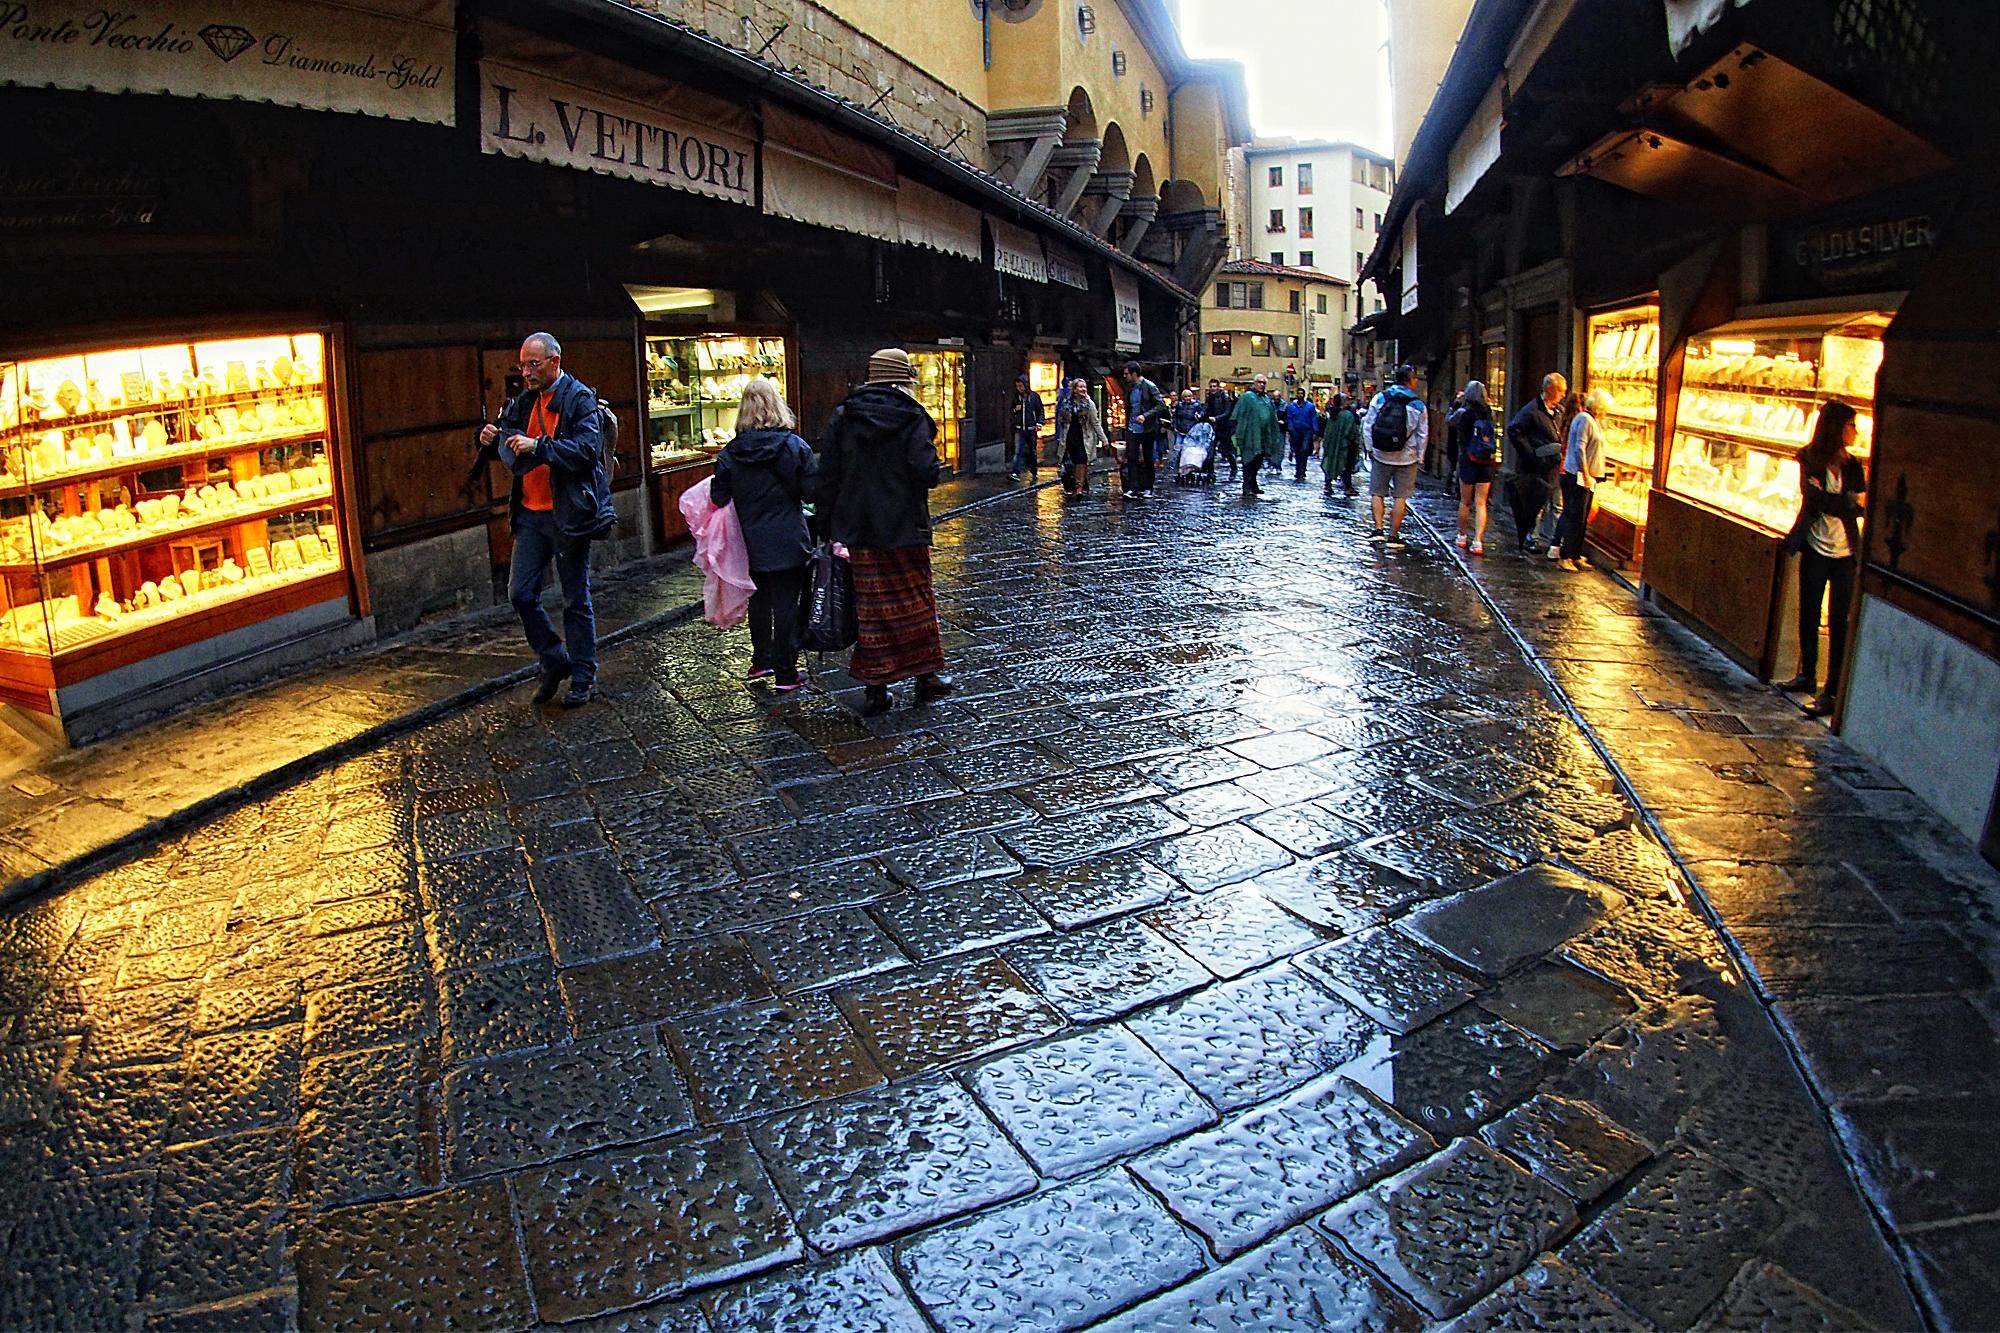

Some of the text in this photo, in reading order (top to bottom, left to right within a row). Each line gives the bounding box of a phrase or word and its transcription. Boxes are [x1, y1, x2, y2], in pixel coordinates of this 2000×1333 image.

[0, 2, 193, 53] Ponte Vecchio
[491, 84, 748, 192] L. VETTORI
